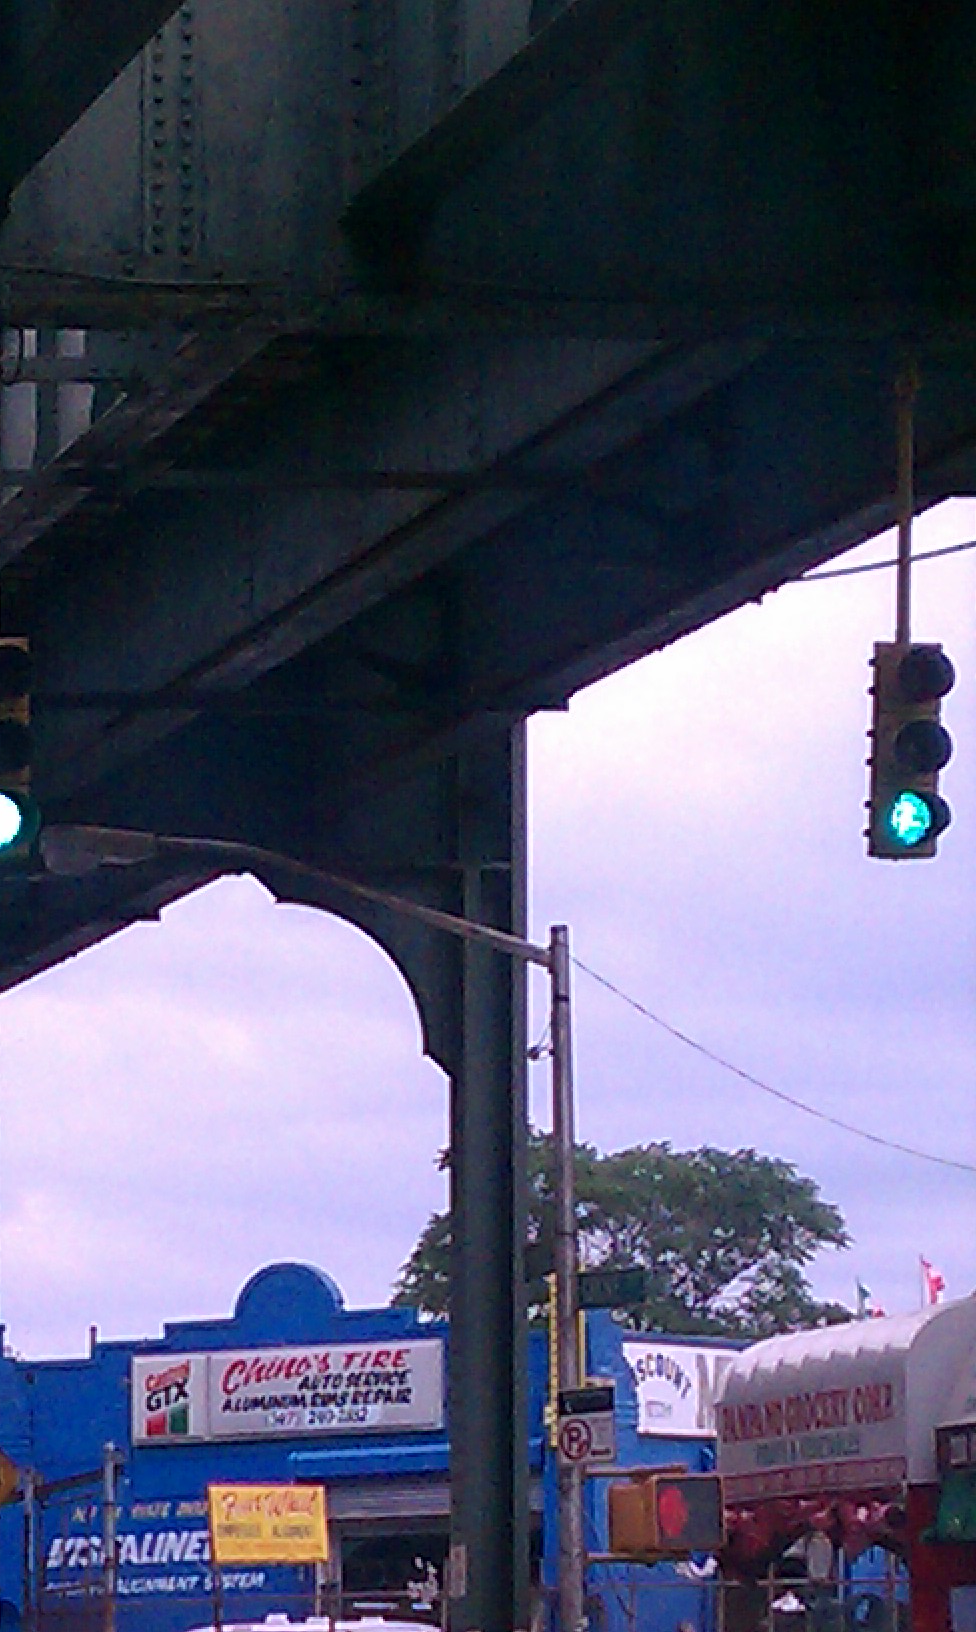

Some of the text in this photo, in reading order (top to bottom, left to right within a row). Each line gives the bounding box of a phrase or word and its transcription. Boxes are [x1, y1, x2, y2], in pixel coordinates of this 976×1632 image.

[342, 1348, 412, 1370] TIRE
[297, 1368, 412, 1391] AUTO SERVICE
[146, 1378, 190, 1411] GTX
[352, 1387, 413, 1405] REPAIR
[204, 1571, 266, 1593] SSTEM
